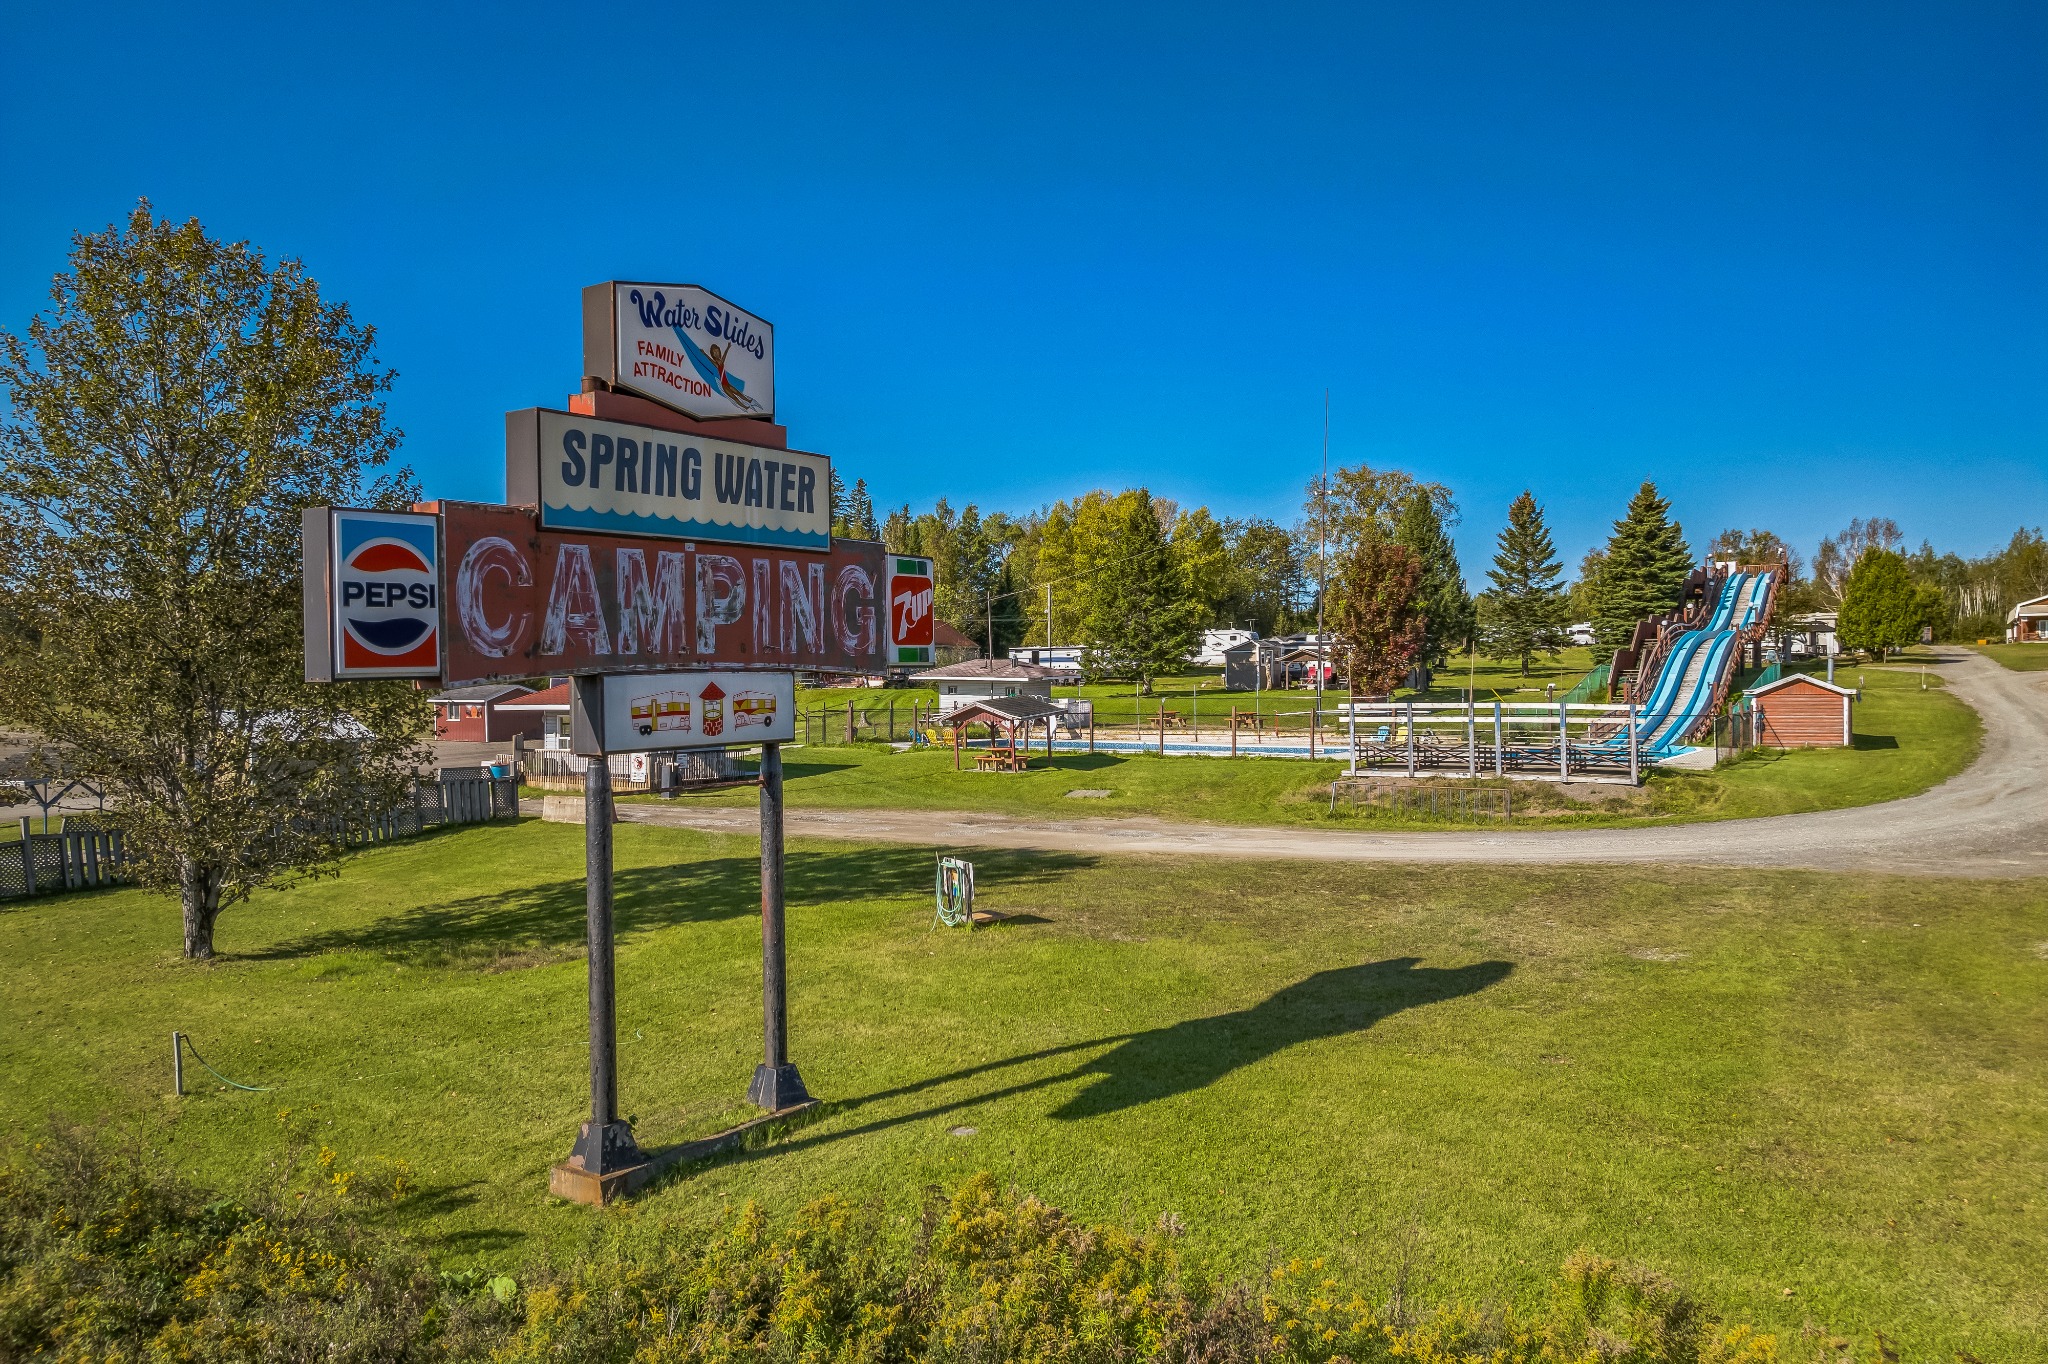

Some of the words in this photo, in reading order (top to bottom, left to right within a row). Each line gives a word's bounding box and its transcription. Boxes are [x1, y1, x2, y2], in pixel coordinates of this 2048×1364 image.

[630, 289, 701, 330] Water
[704, 305, 764, 360] Slides
[633, 361, 712, 398] ATTRACTION
[637, 340, 685, 368] FAMILY
[561, 429, 702, 500] SPRING
[714, 453, 816, 514] WATER
[342, 580, 436, 609] PEPSI
[456, 536, 876, 658] CAMPING
